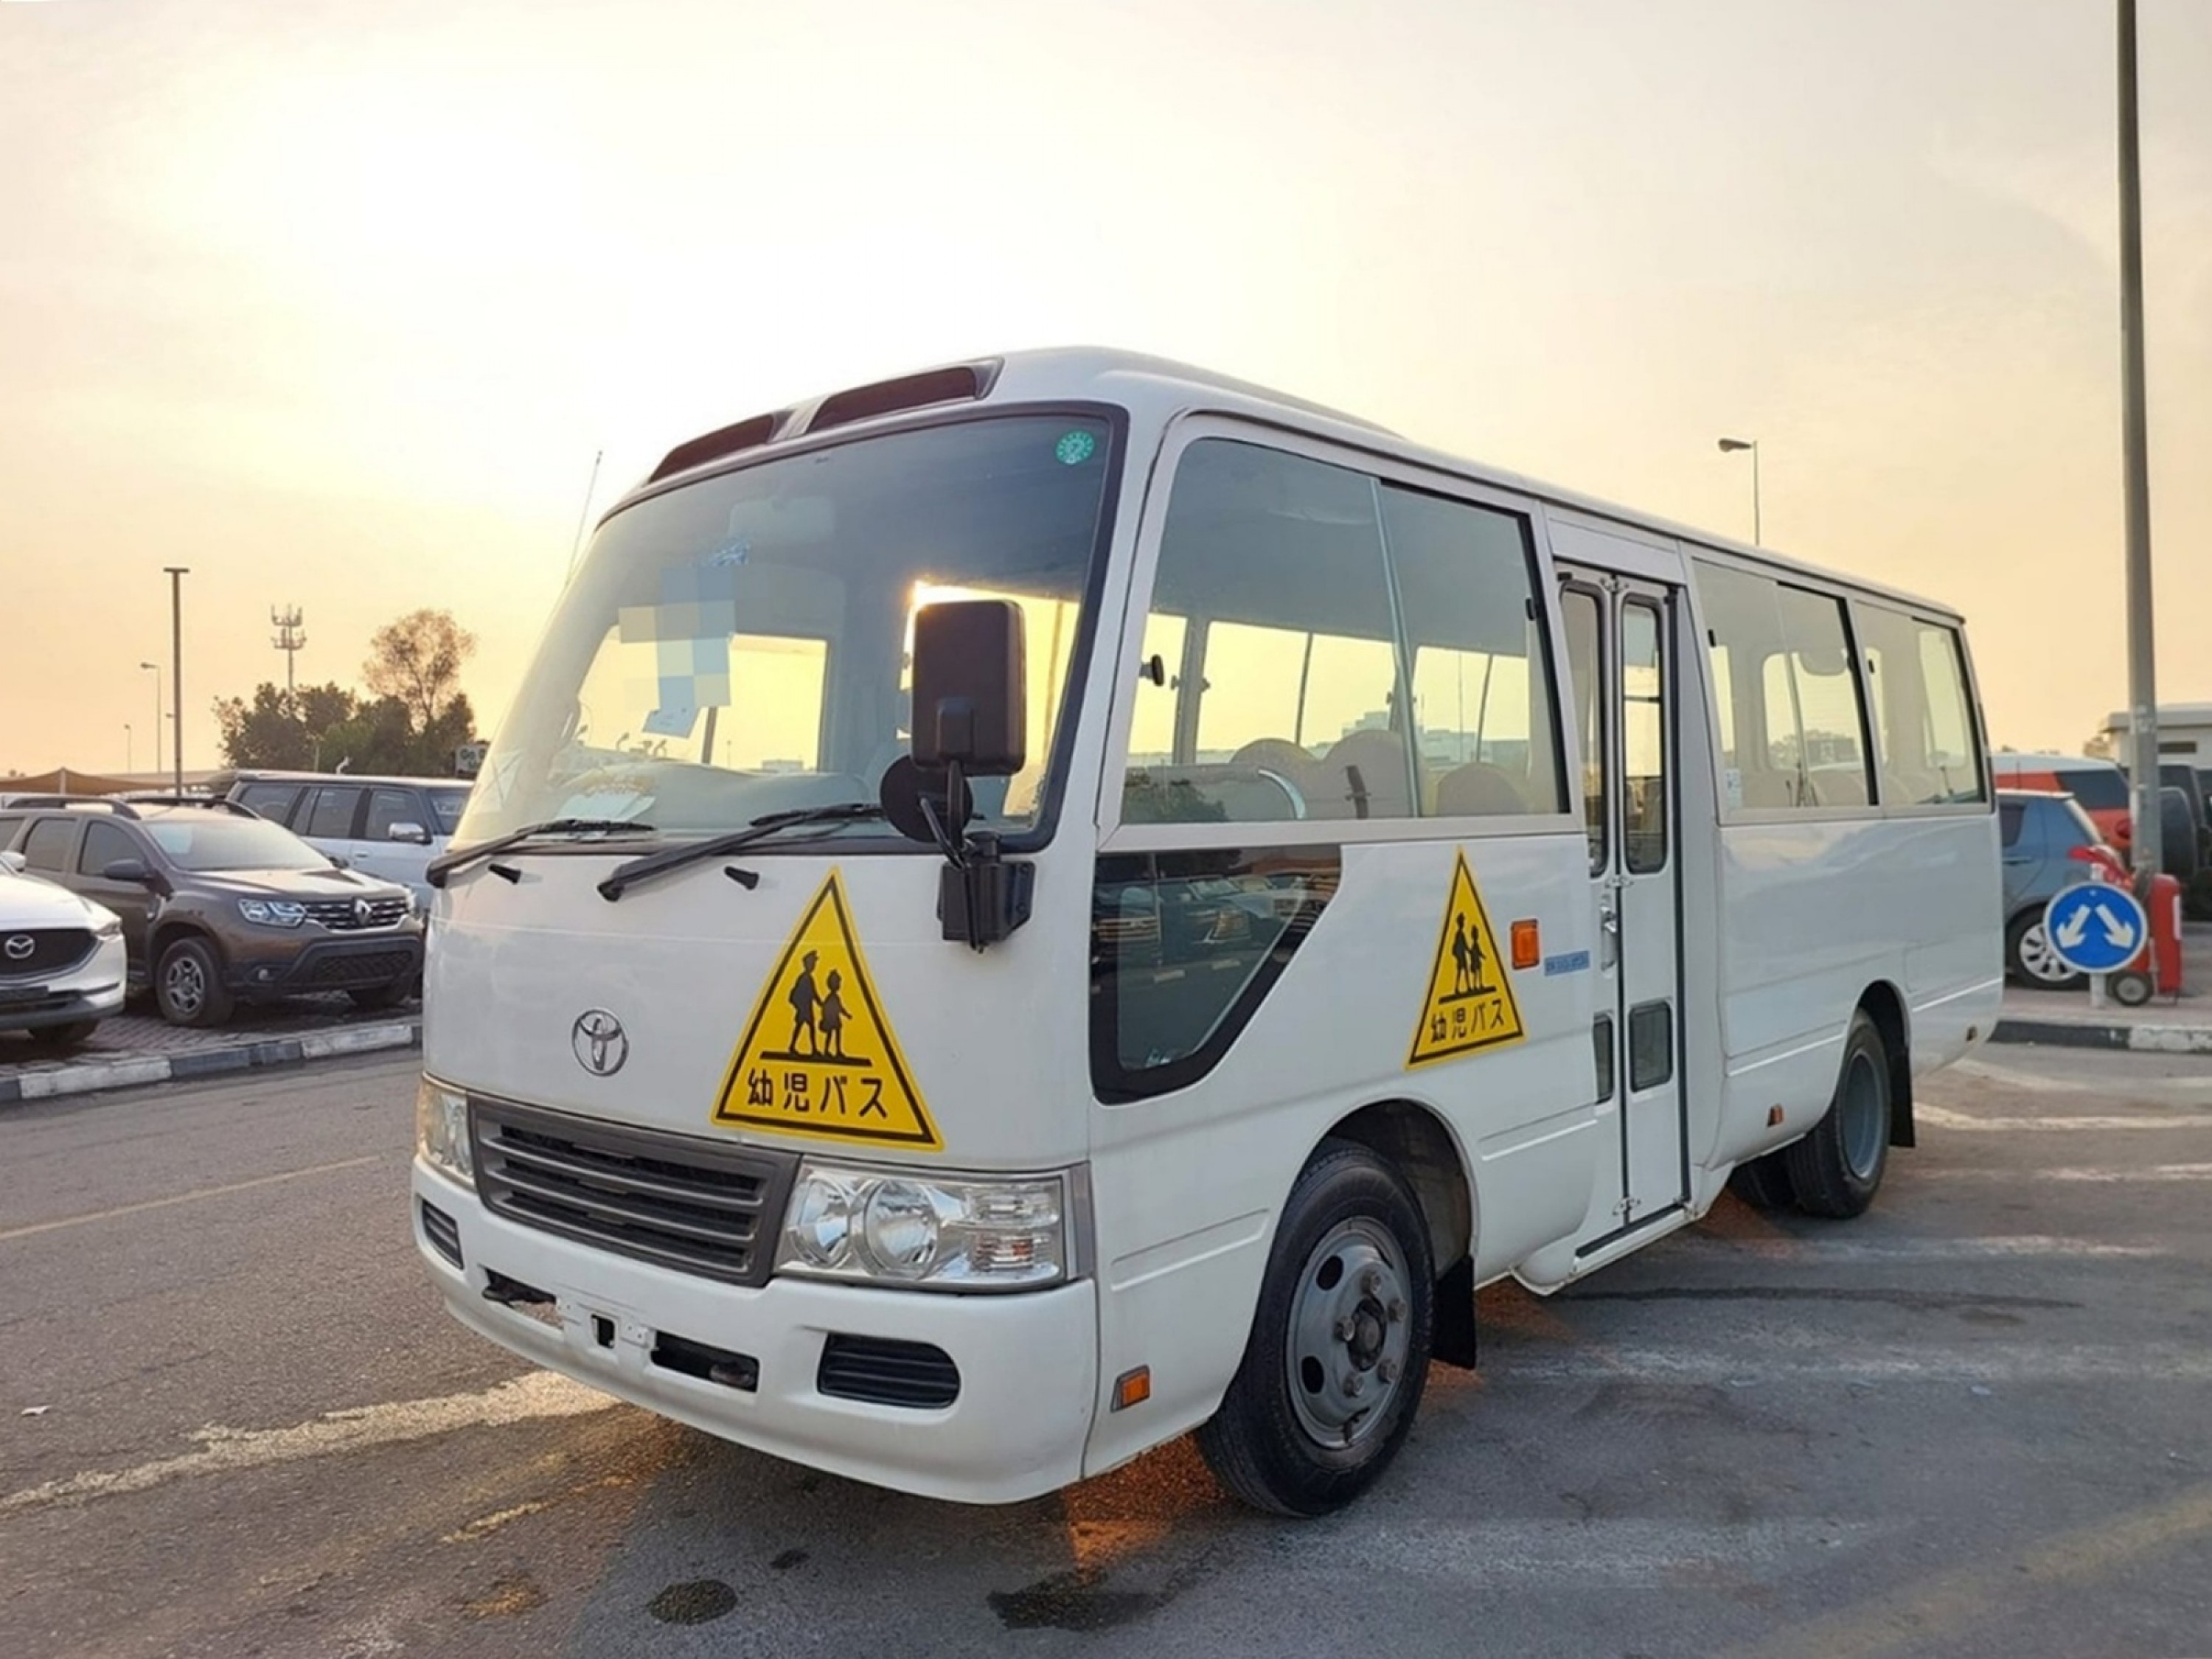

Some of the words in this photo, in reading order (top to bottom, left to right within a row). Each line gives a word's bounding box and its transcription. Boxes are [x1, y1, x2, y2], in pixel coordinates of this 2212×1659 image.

[1430, 999, 1504, 1043] 幼児バス
[748, 1068, 887, 1118] 幼児バス
